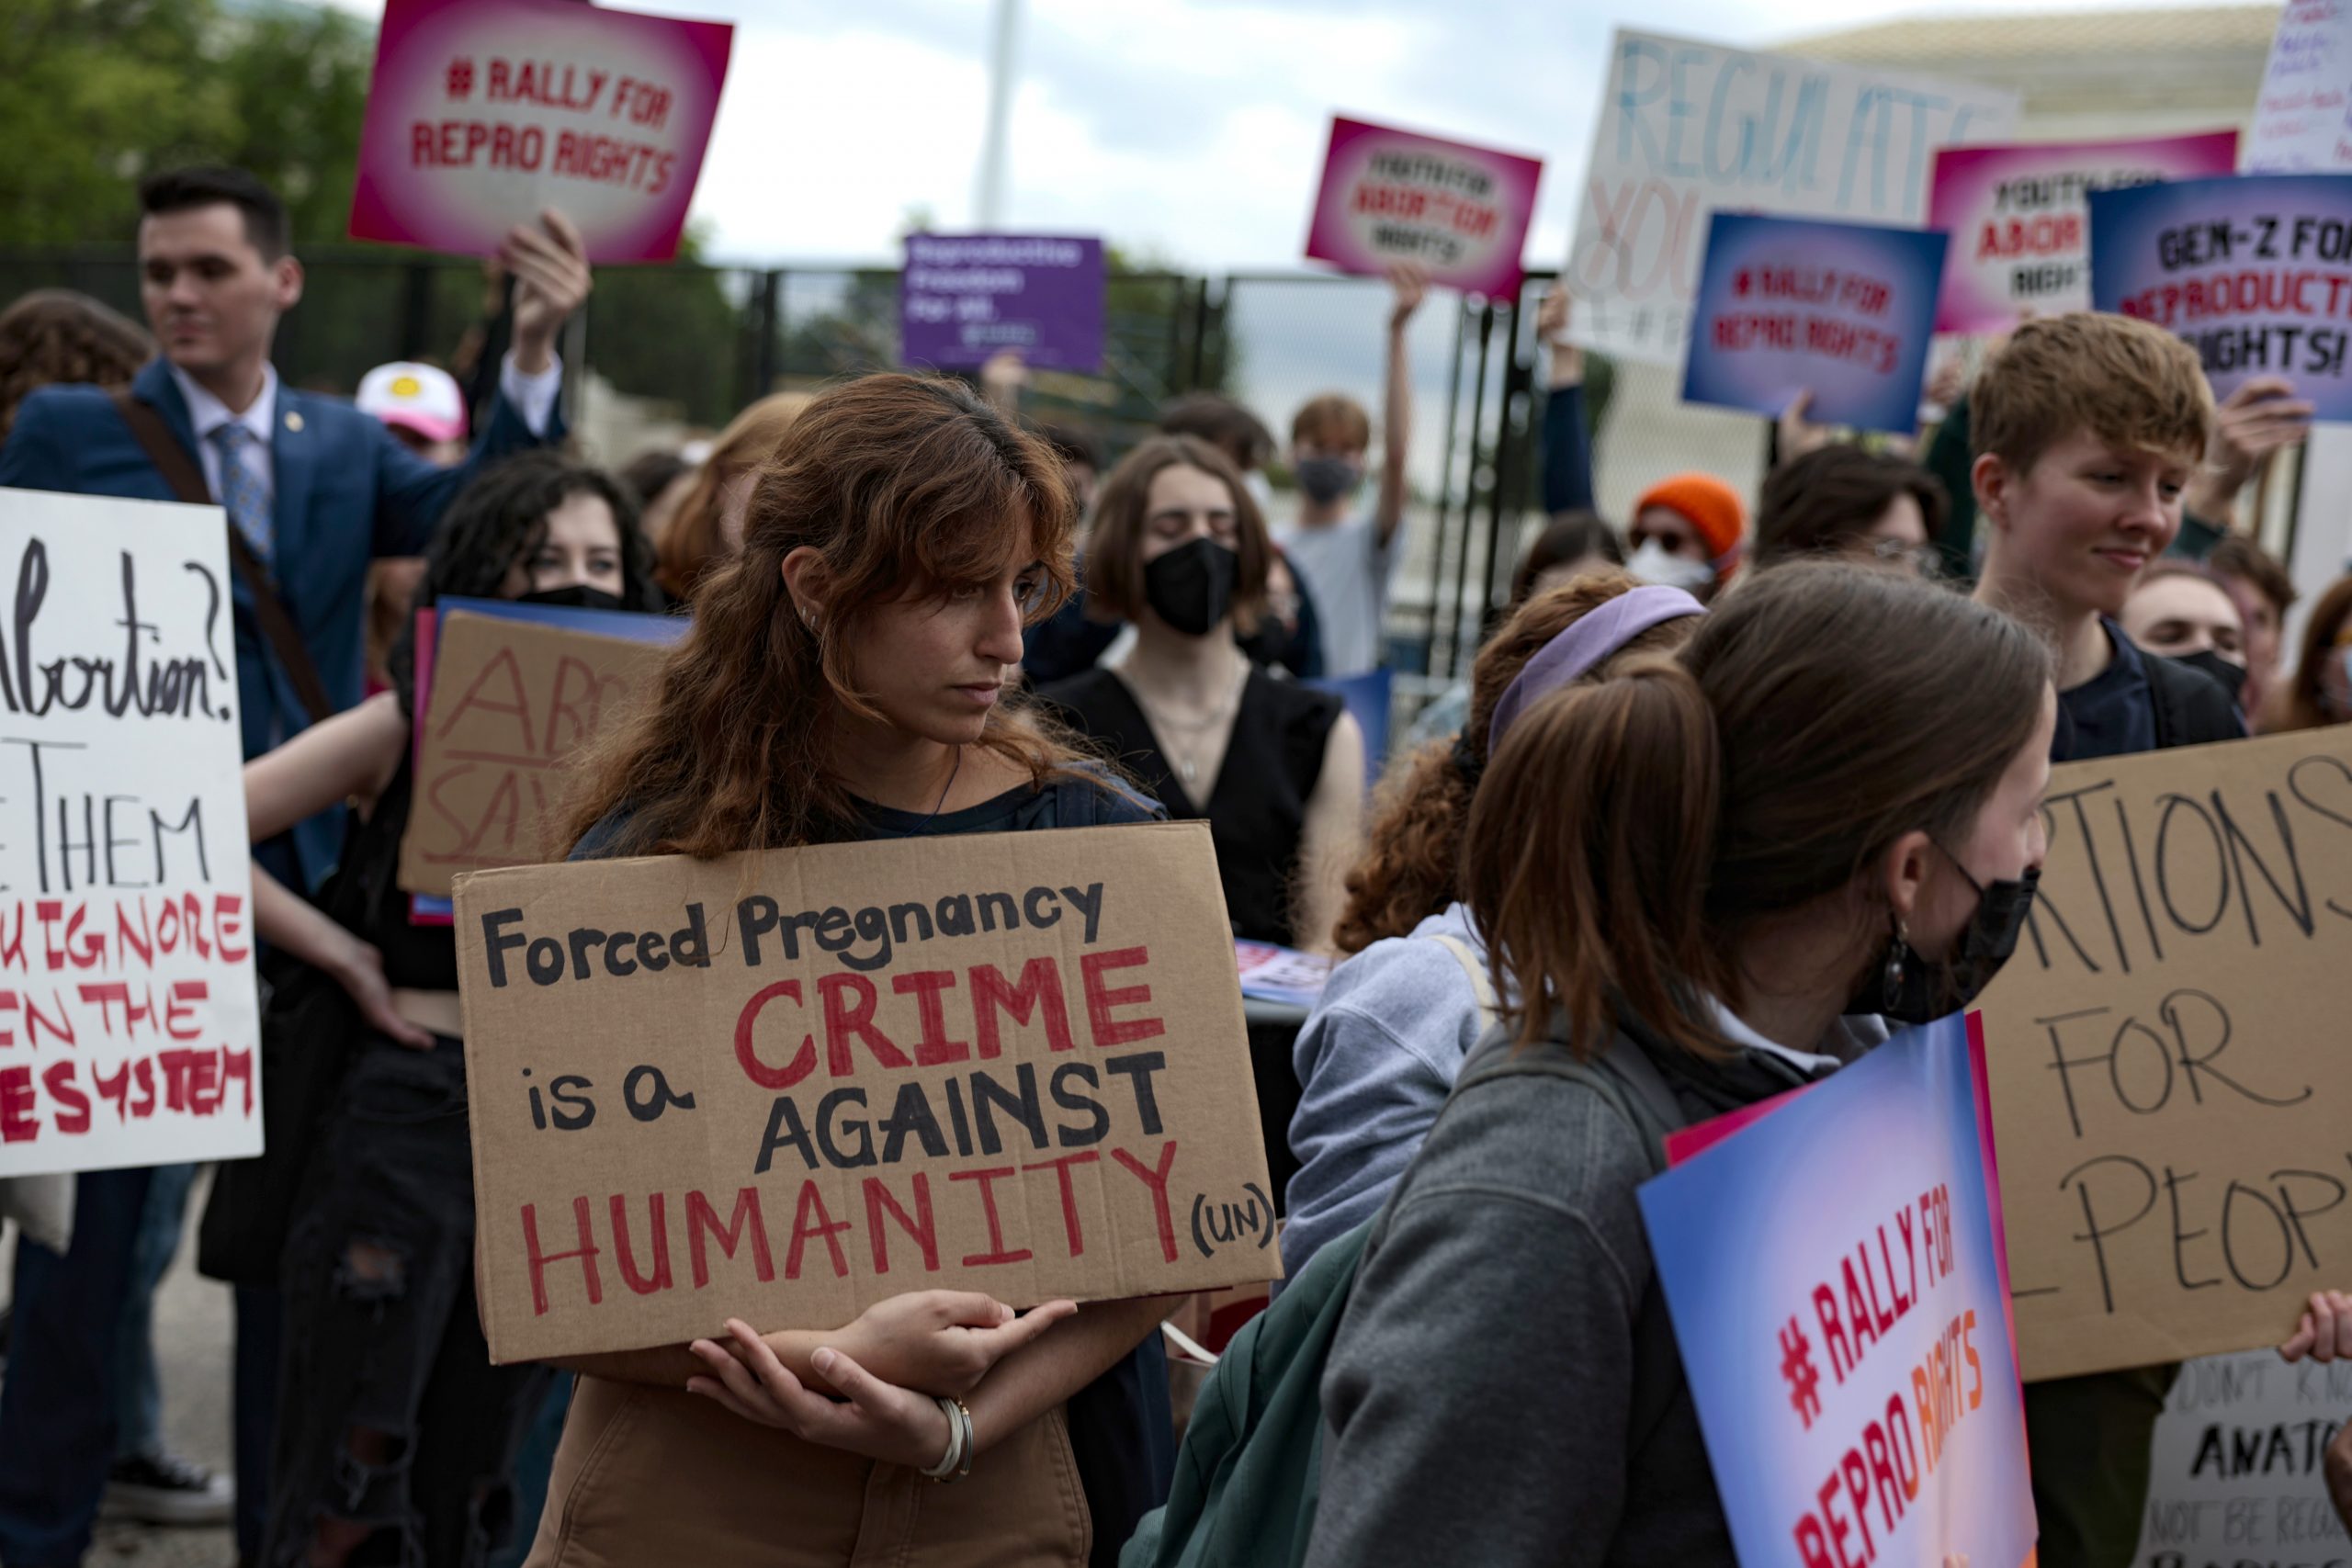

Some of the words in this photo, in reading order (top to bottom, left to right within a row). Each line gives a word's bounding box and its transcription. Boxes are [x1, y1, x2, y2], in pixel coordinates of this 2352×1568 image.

[486, 58, 608, 114] RALLY
[610, 75, 673, 129] FOR
[410, 119, 547, 173] REPRO
[553, 130, 677, 196] RIGHTS
[1976, 212, 2084, 265] ABOR
[2159, 215, 2280, 272] GEN-Z
[2178, 325, 2347, 379] IGHTS!
[2, 737, 212, 895] THEM
[481, 901, 713, 989] Forced
[738, 882, 1104, 972] Pregnancy
[77, 979, 209, 1045] THE
[735, 945, 1166, 1090] CRIME
[2034, 987, 2313, 1140] FOR
[522, 1066, 597, 1131] is
[622, 1064, 696, 1123] a
[754, 1051, 1167, 1175] AGAINST
[521, 1139, 1180, 1317] HUMANITY
[1192, 1181, 1276, 1259] (UN)
[1812, 1203, 1918, 1386] RALLY
[1918, 1181, 1955, 1289] FOR
[2059, 1151, 2352, 1315] PEOP
[1792, 1391, 1921, 1568] REPRO
[1910, 1309, 1984, 1474] RIGHTS
